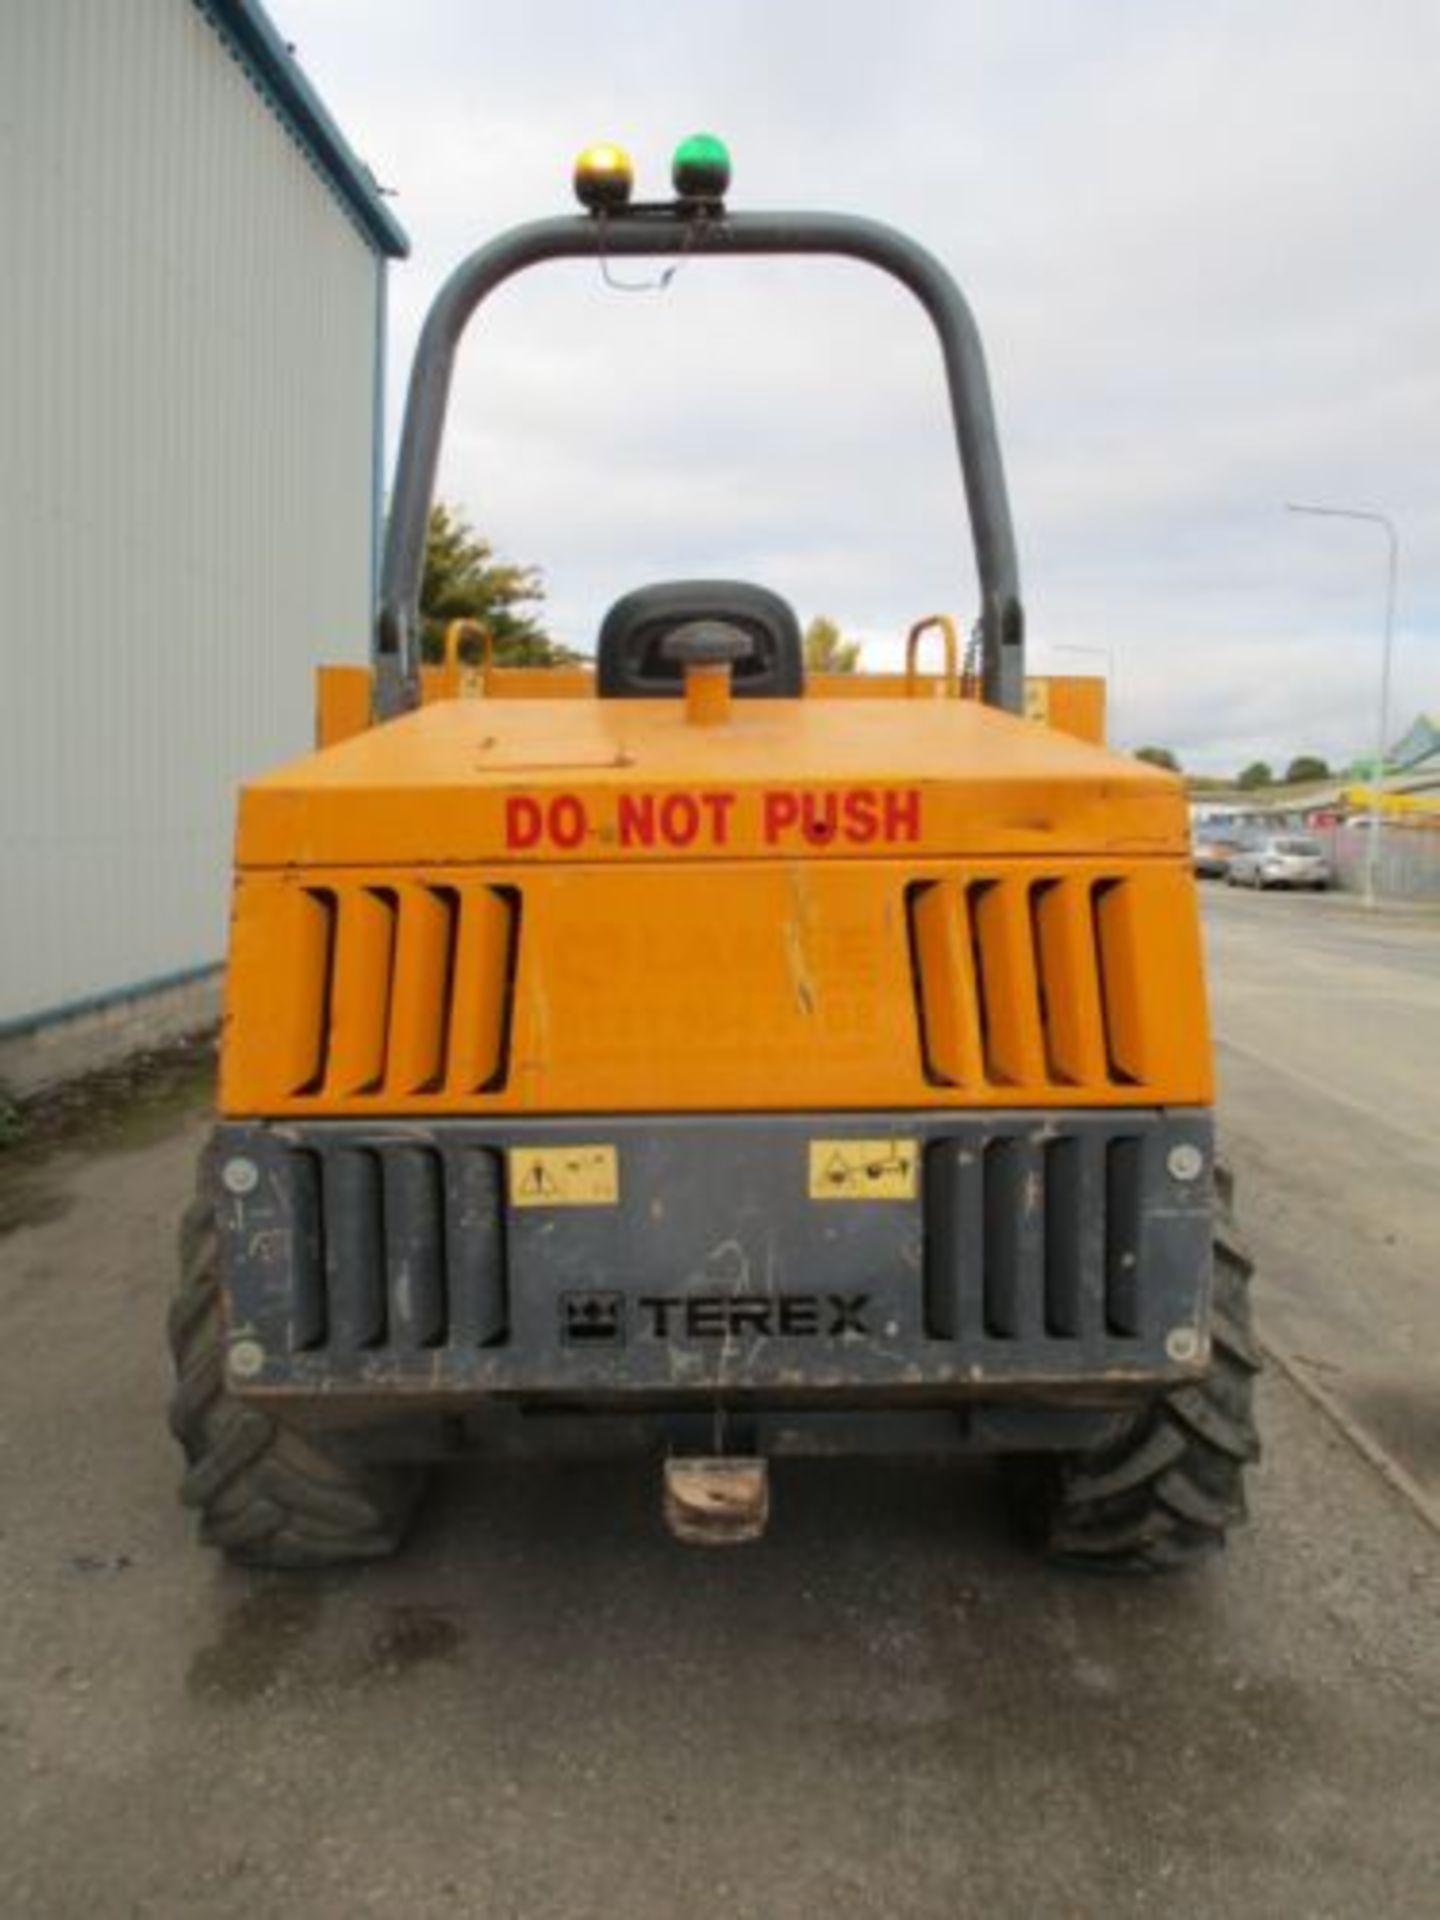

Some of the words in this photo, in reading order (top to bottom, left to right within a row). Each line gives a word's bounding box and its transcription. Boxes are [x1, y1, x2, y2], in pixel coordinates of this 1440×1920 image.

[505, 794, 588, 849] DO
[618, 792, 734, 847] NOT
[764, 789, 921, 846] PUSH
[639, 1295, 872, 1338] TEREX
